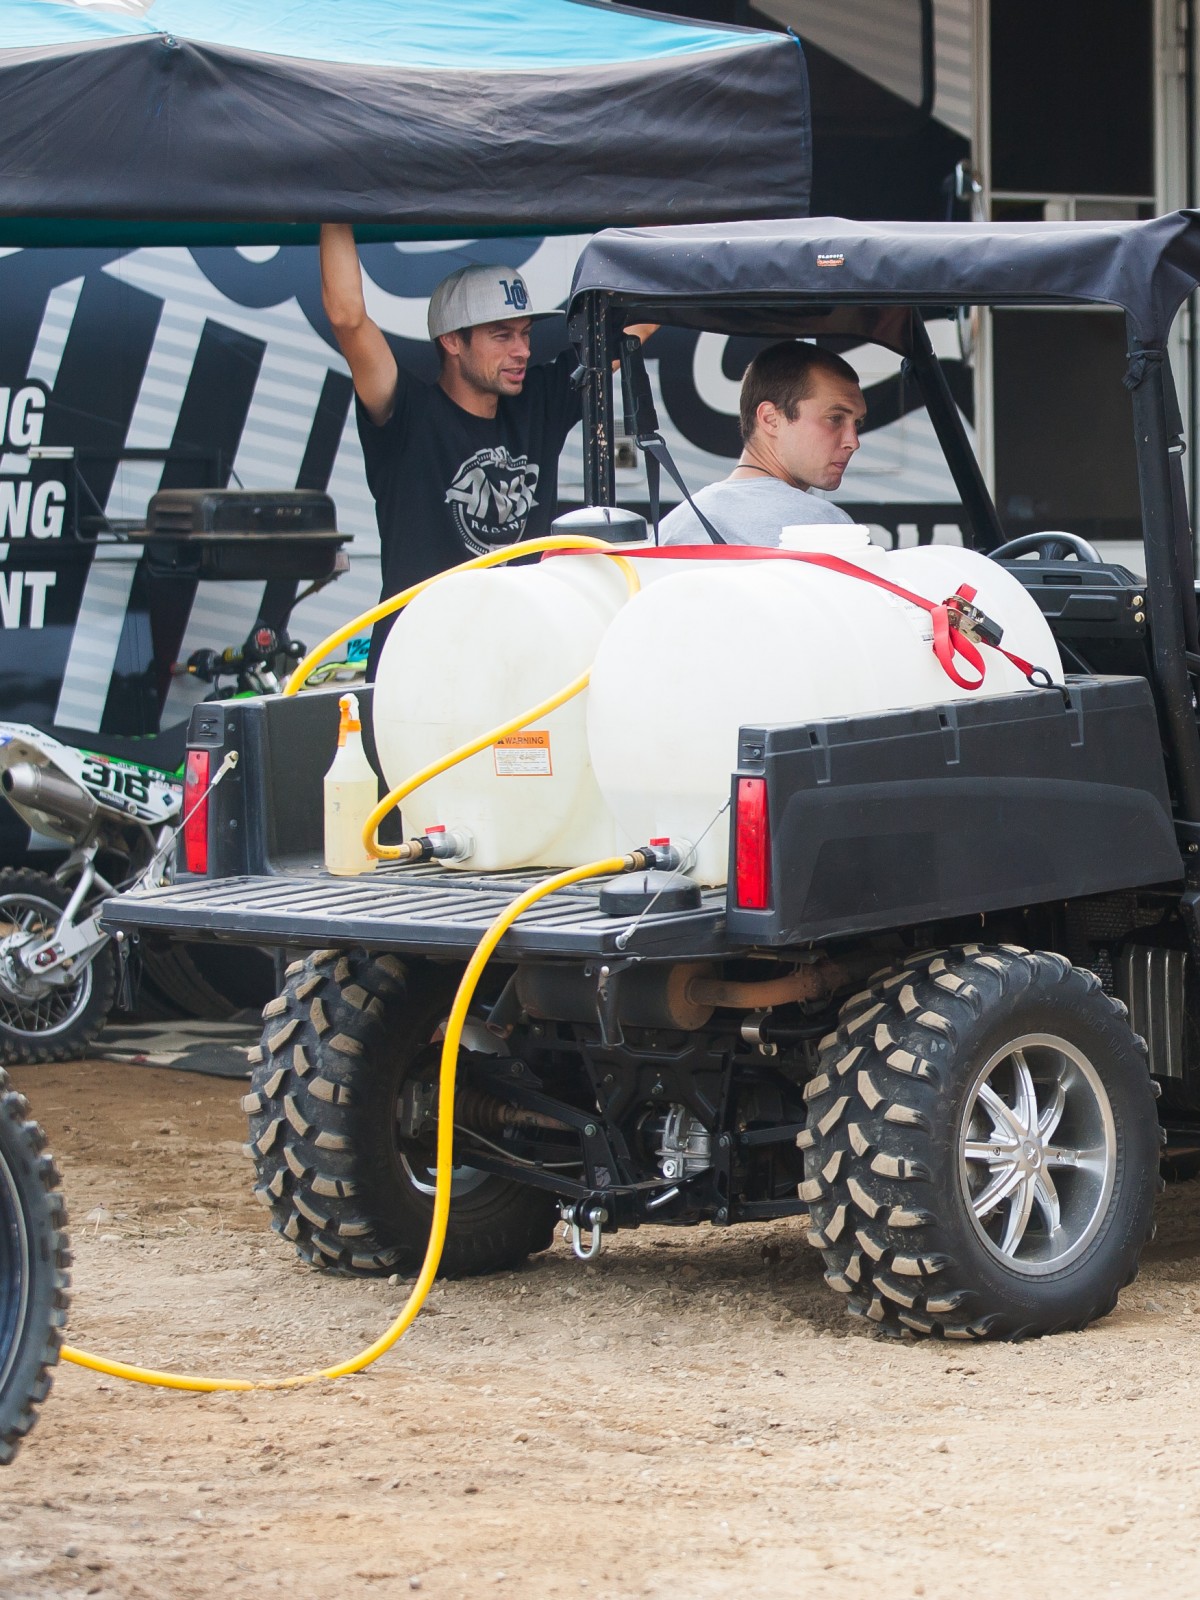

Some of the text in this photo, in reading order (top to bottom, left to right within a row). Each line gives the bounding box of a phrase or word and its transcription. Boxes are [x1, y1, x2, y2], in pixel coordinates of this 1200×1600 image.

[0, 386, 46, 446] G
[505, 736, 545, 745] WARNING
[81, 758, 150, 804] 316
